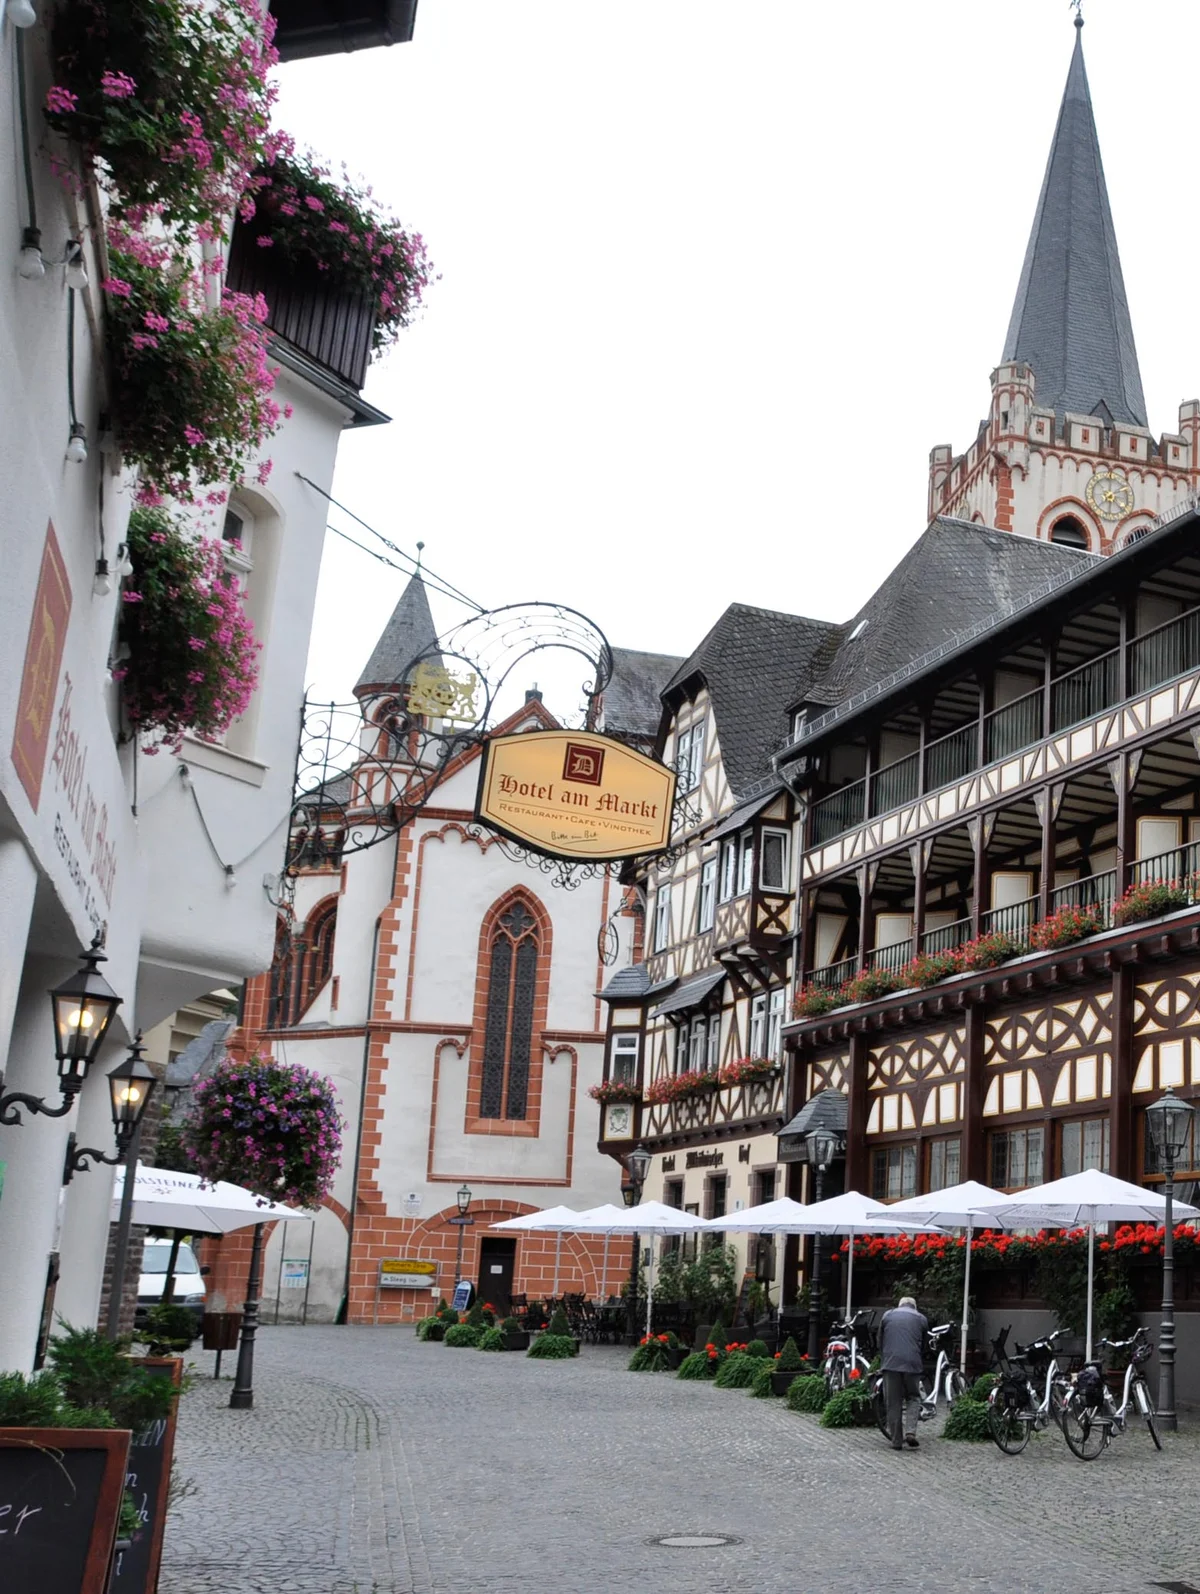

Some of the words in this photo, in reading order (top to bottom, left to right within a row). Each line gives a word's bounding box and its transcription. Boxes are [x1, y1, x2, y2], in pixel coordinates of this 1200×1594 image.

[498, 773, 554, 801] Hotel
[561, 790, 589, 808] am
[595, 792, 658, 819] Markt
